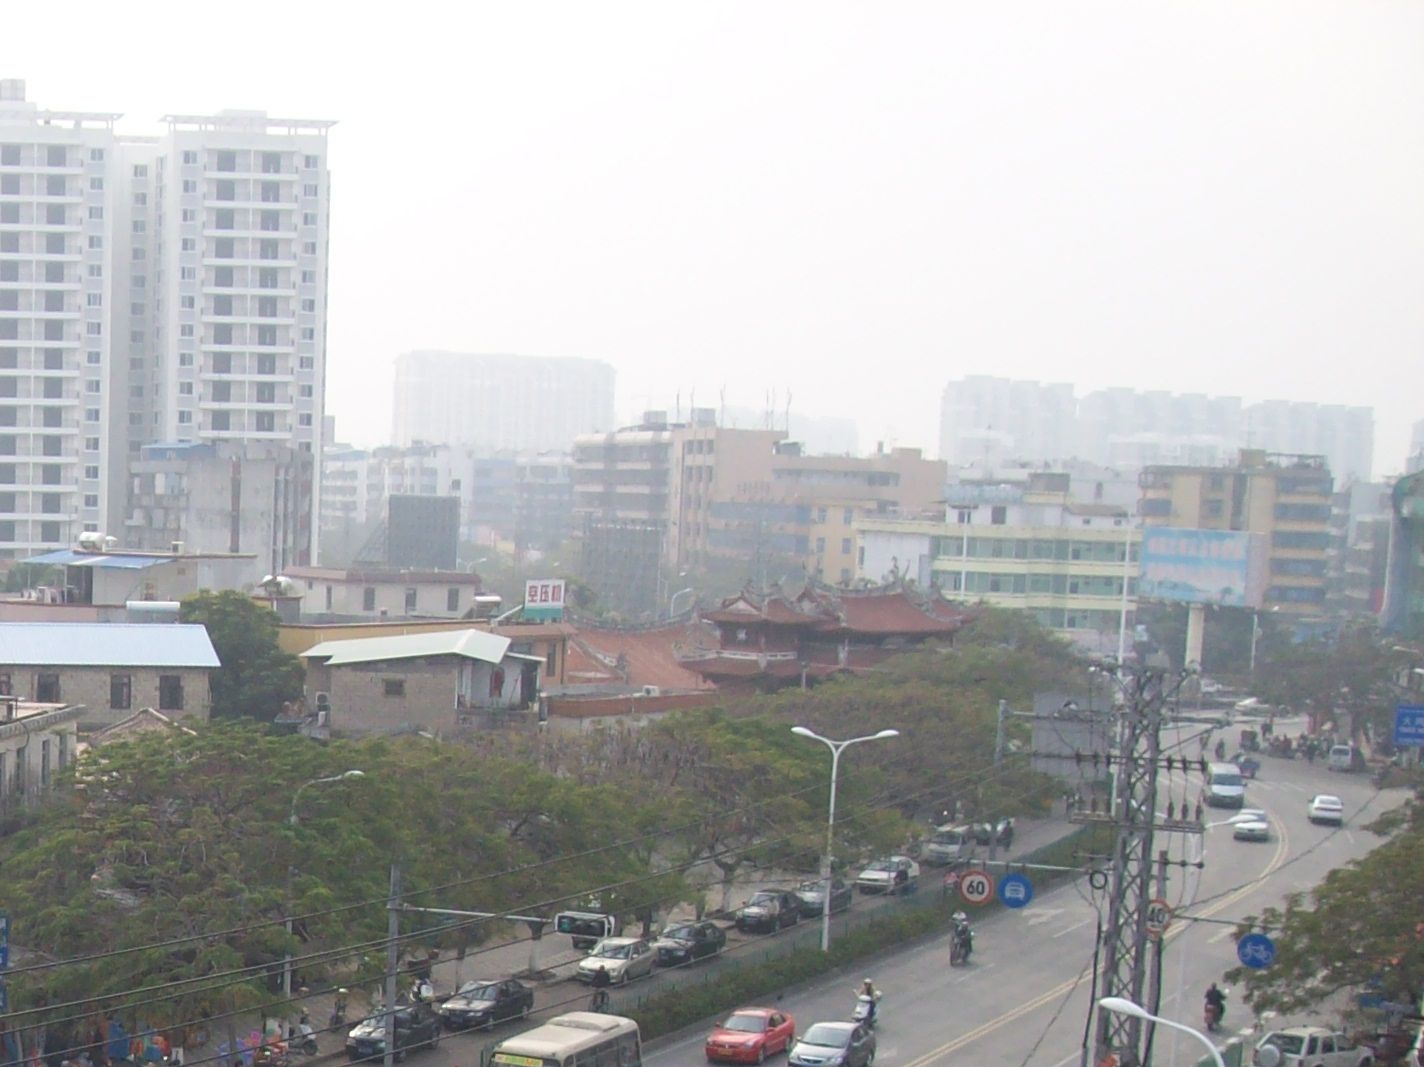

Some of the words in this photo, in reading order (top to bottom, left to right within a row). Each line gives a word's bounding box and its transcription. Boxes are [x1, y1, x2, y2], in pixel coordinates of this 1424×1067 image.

[528, 585, 562, 603] 空压机
[967, 879, 985, 895] 60
[1148, 907, 1166, 924] 40
